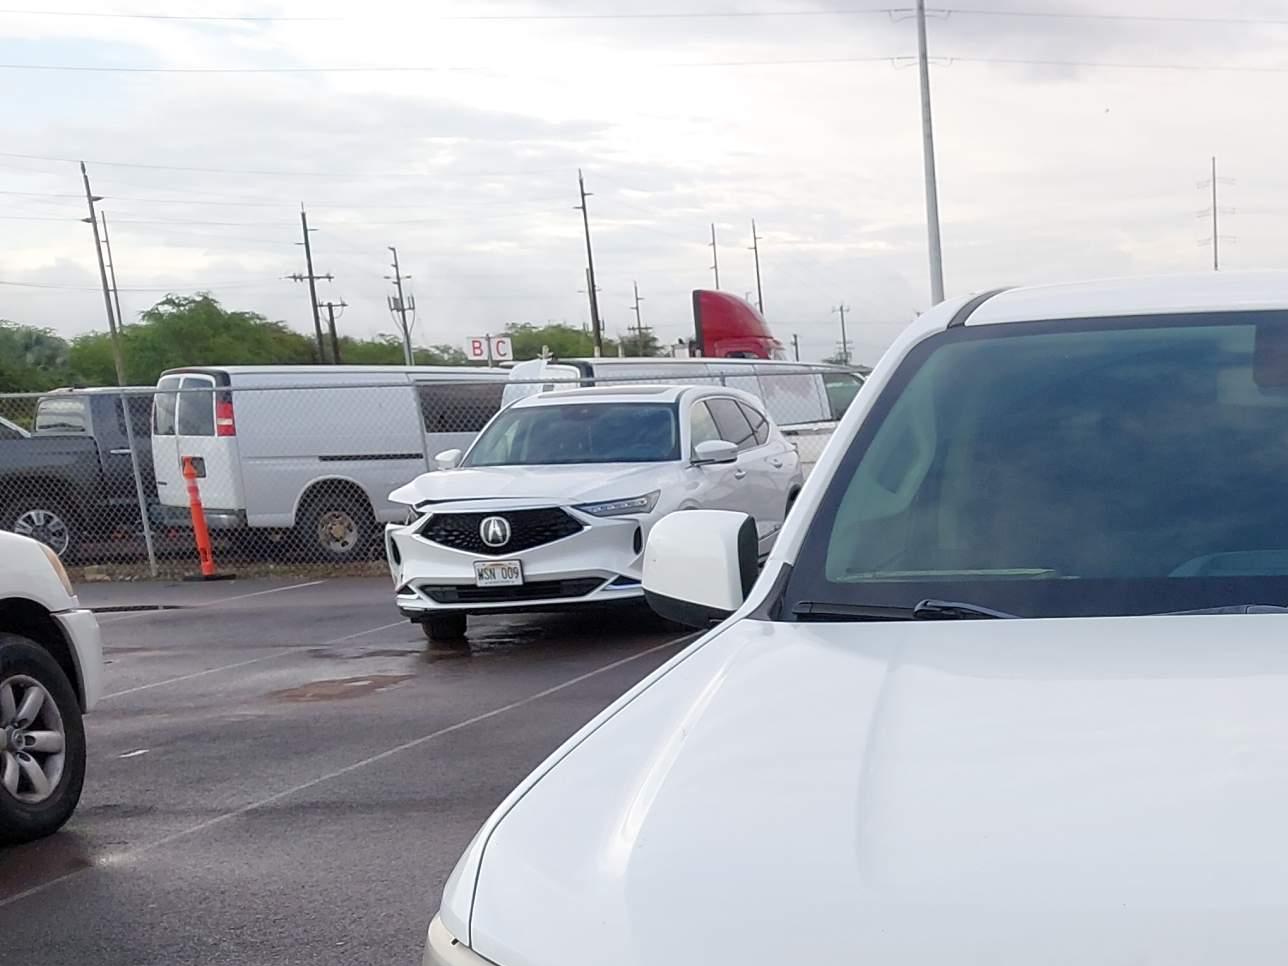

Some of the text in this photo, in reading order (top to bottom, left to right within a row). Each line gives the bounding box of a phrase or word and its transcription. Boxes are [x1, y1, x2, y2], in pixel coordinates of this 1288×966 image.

[471, 340, 508, 357] B C
[477, 567, 497, 581] WSN
